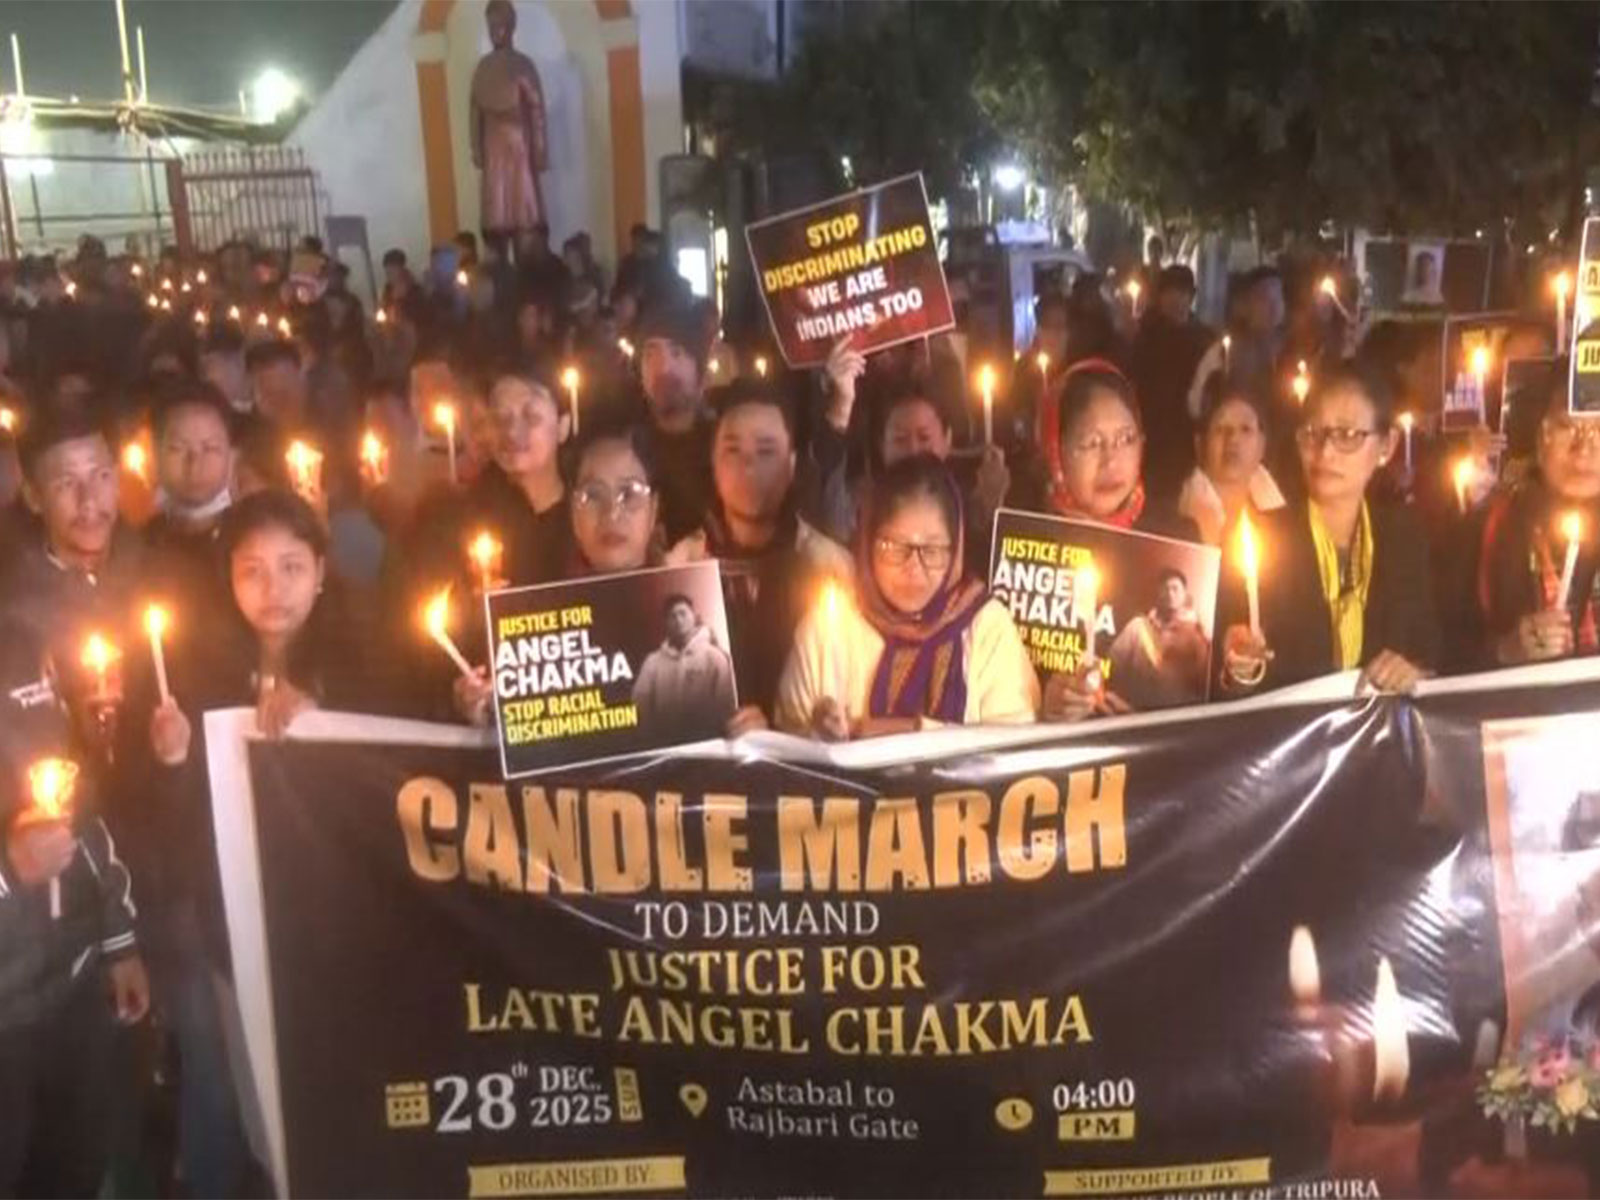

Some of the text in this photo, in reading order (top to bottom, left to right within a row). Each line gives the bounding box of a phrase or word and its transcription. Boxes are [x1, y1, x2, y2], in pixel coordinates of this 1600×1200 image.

[807, 213, 859, 248] STOP
[764, 225, 926, 291] DISCRIMINATING
[807, 267, 887, 308] WE ARE
[797, 288, 923, 341] INDIANS TOO
[1002, 537, 1057, 563] JUSTICE
[993, 560, 1074, 599] ANGE
[499, 606, 592, 639] JUSTICE FOR
[496, 629, 602, 669] ANGEL
[1031, 627, 1081, 653] RACIAL
[498, 652, 633, 698] CHAKMA
[504, 690, 605, 723] STOP RACIAL
[507, 705, 637, 744] DISCRIMINATION
[396, 763, 1127, 894] CANDLE MARCH
[635, 901, 880, 940] TO DEMAND
[609, 945, 925, 996] JUSTICE FOR
[463, 983, 1094, 1056] LATE ANGEL CHAKMA
[738, 1076, 895, 1107] Astabal to
[1053, 1078, 1135, 1111] 04:00
[530, 1094, 612, 1127] 2025
[727, 1106, 919, 1139] Rajbari Gate
[1073, 1117, 1120, 1136] PM
[499, 1166, 618, 1190] ORGANISED
[1075, 1168, 1205, 1190] SUPPORTED
[1282, 1179, 1380, 1199] TRIPURA
